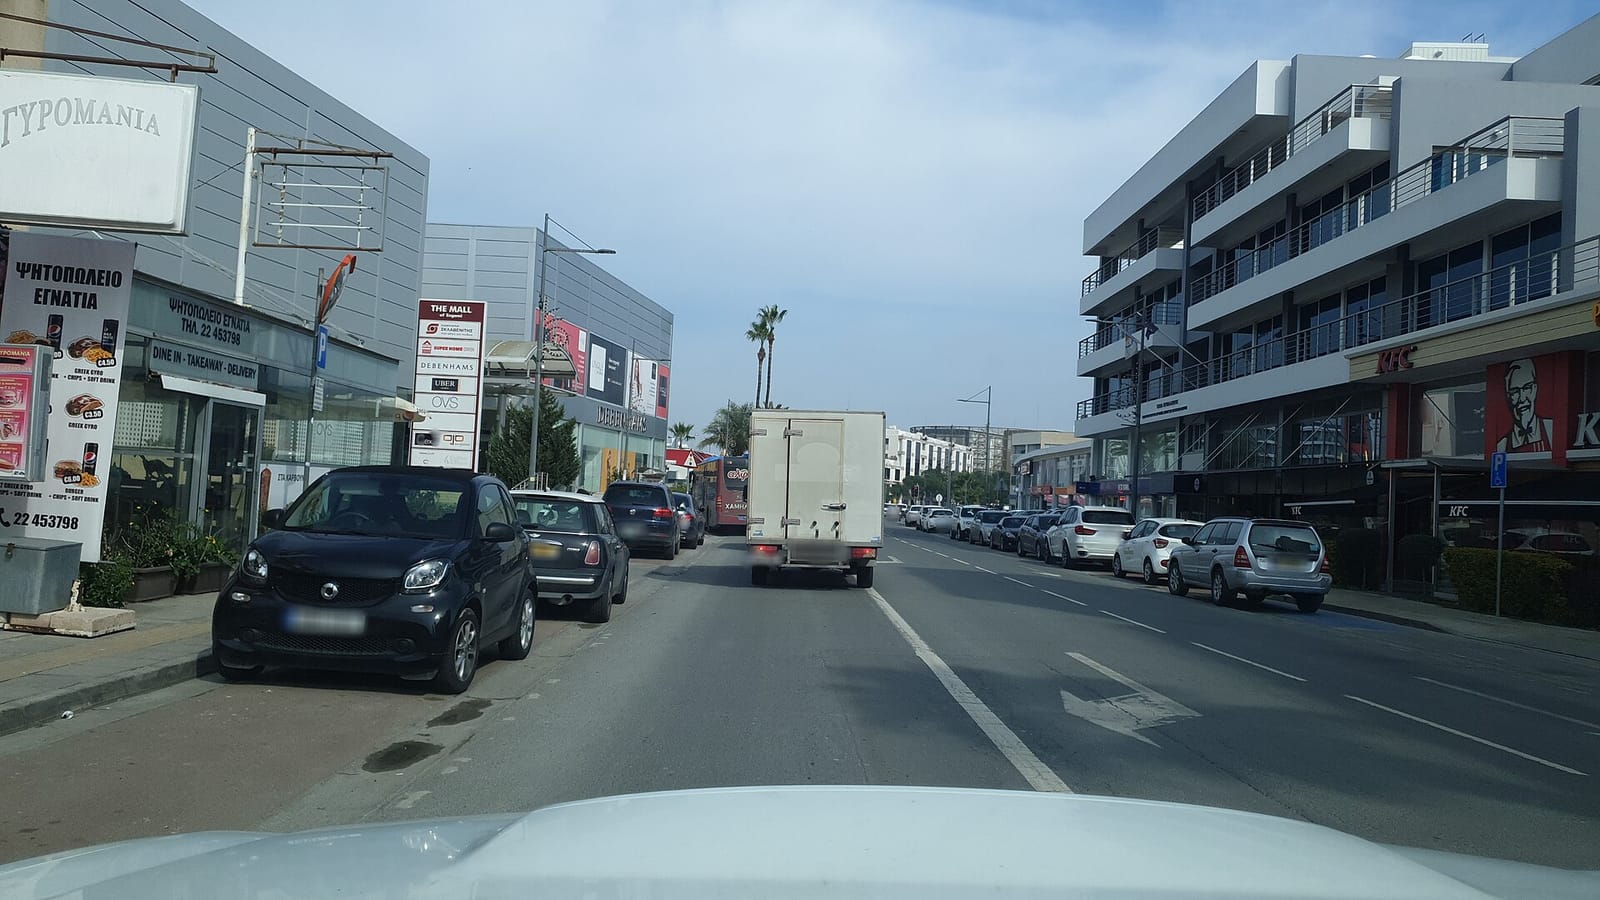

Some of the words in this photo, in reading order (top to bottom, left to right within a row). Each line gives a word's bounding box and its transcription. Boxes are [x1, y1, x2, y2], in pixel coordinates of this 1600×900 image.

[1, 97, 160, 148] ΓΥΡΟΜΑΝΙΑ
[16, 262, 122, 287] ΨΗΤΟΠΩΛΕΙΟ
[34, 288, 97, 310] ΕΓΝΑΤΙΑ
[430, 304, 447, 313] THE
[448, 305, 473, 314] MALL
[169, 297, 222, 325] ΨΗΤΟΠΩΛΕΙΟ
[223, 314, 250, 333] ΕΓΝΑΤΙΑ
[200, 323, 211, 338] 22
[212, 328, 240, 346] 453798
[153, 346, 172, 360] DINE
[173, 351, 182, 364] IN
[187, 353, 223, 372] TAKEAWAY
[227, 363, 256, 379] DELIVERY
[420, 362, 474, 371] DEBENHAMS
[1375, 345, 1414, 374] KFC
[432, 395, 459, 409] OVS
[13, 512, 29, 526] 22
[31, 514, 79, 530] 453798
[1449, 505, 1469, 517] KFC
